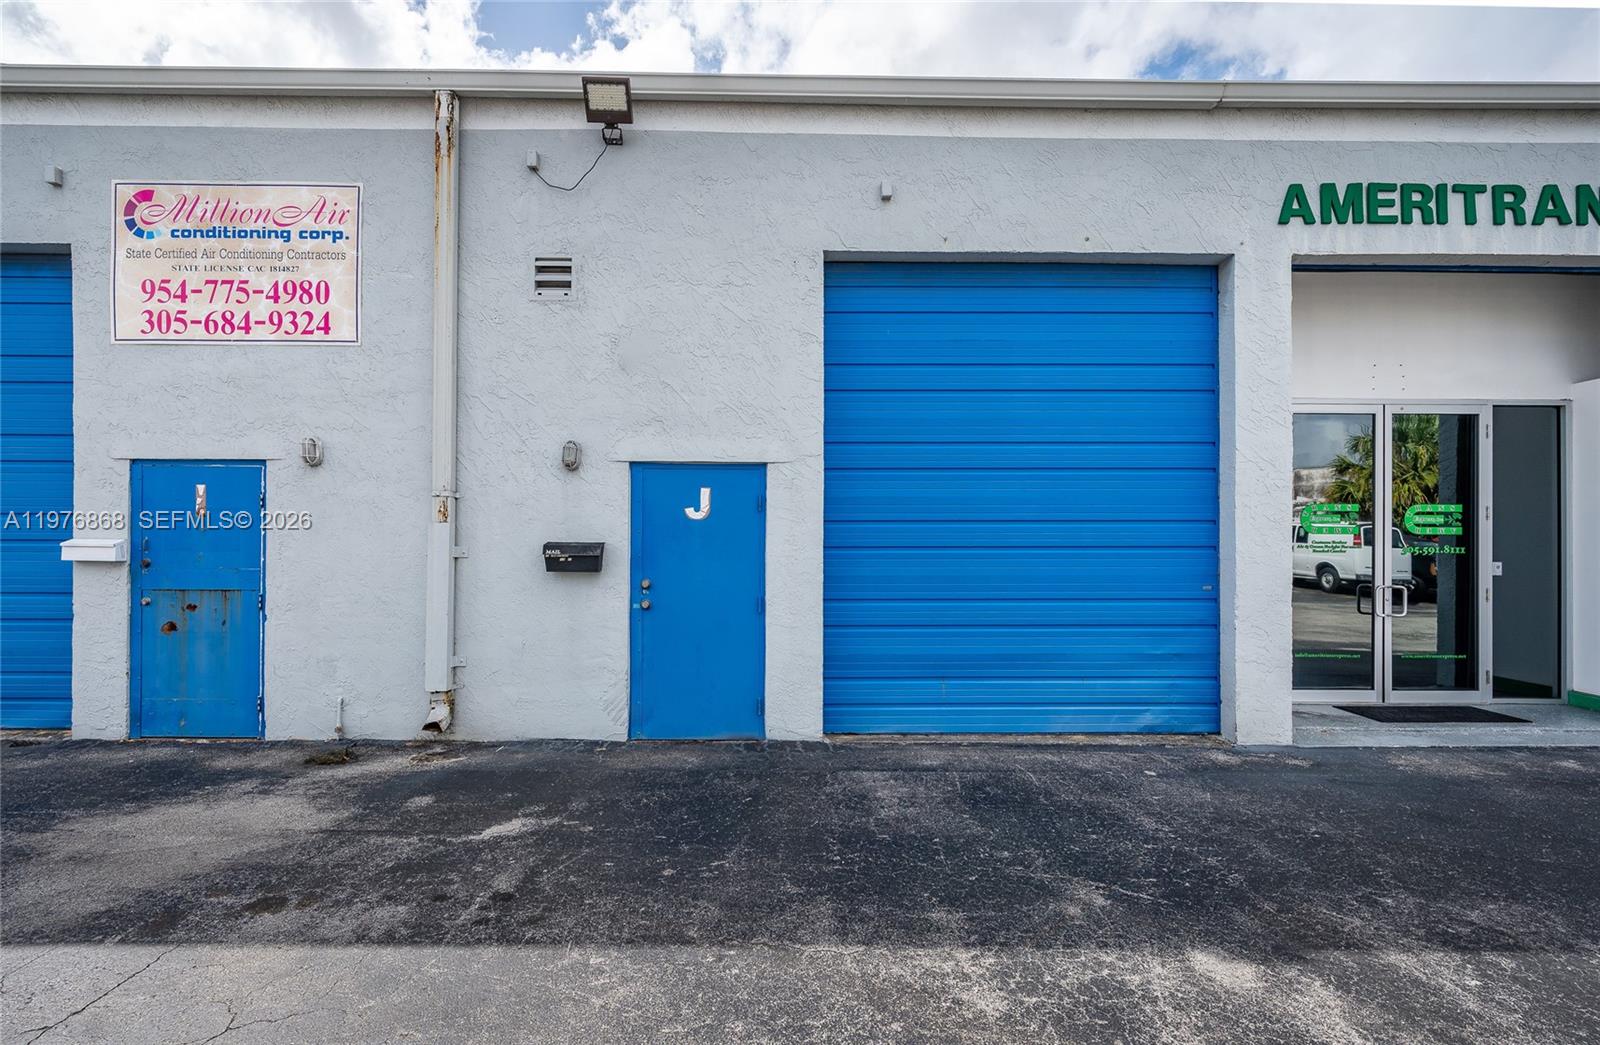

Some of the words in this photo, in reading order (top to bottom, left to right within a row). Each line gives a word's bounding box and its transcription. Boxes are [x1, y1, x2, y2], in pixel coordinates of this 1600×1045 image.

[140, 194, 271, 226] Million
[272, 195, 350, 227] Air
[170, 226, 291, 242] conditioning
[298, 228, 350, 243] corp.
[125, 248, 151, 260] State
[154, 248, 197, 260] Certified
[202, 249, 216, 260] Air
[219, 249, 284, 262] Conditioning
[286, 249, 346, 261] Contractors
[171, 265, 200, 273] STATE
[204, 265, 244, 273] LICENSE
[247, 265, 267, 273] CAC
[269, 265, 300, 273] 1814827
[140, 278, 331, 305] 954-775-4980
[140, 309, 332, 336] 305-684-9324
[684, 487, 712, 520] J
